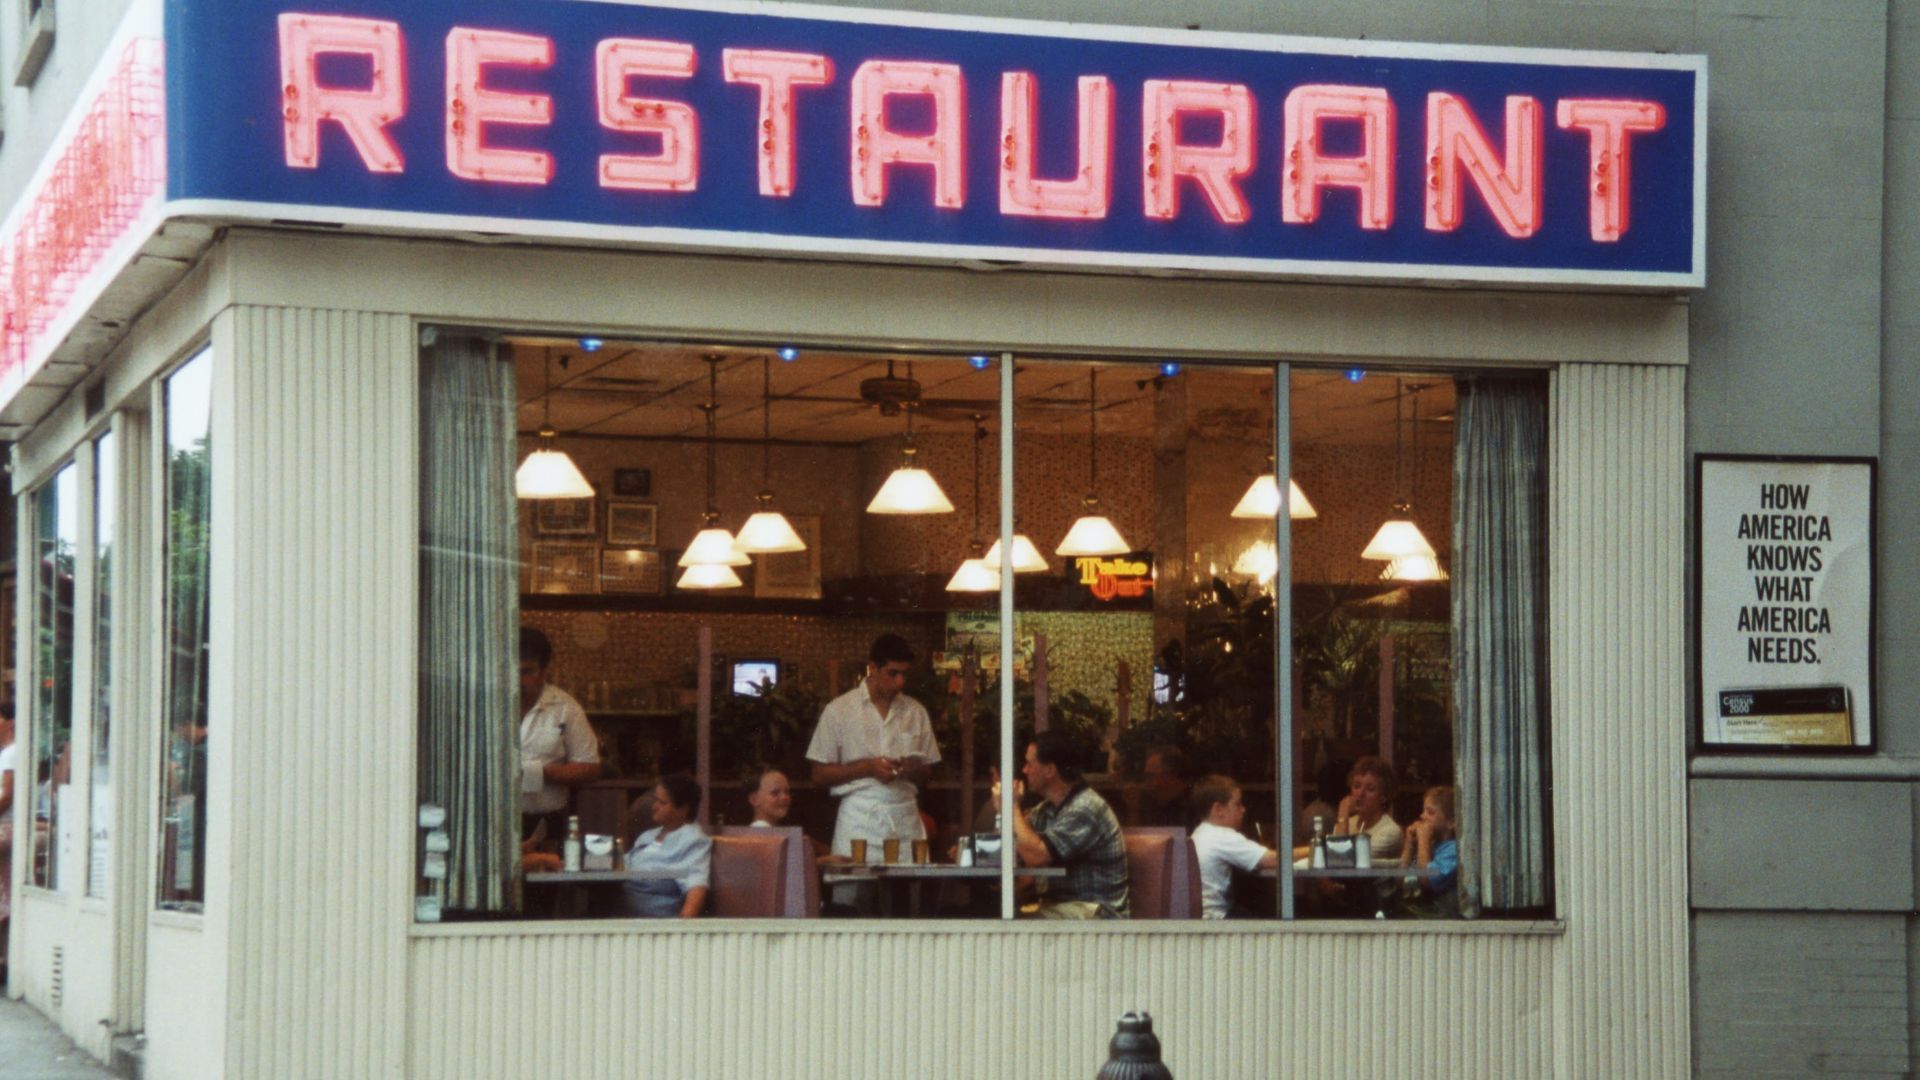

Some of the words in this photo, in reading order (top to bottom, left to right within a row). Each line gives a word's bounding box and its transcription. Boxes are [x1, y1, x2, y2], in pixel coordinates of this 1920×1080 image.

[277, 12, 1668, 244] RESTAURANT
[1760, 483, 1811, 511] HOW
[1737, 513, 1832, 542] AMERICA
[1075, 557, 1148, 584] Take
[1747, 544, 1823, 573] KNOWS
[1754, 575, 1814, 603] WHAT
[1737, 605, 1832, 634] AMERICA
[1747, 636, 1822, 665] NEEDS.
[1729, 704, 1750, 714] 2000
